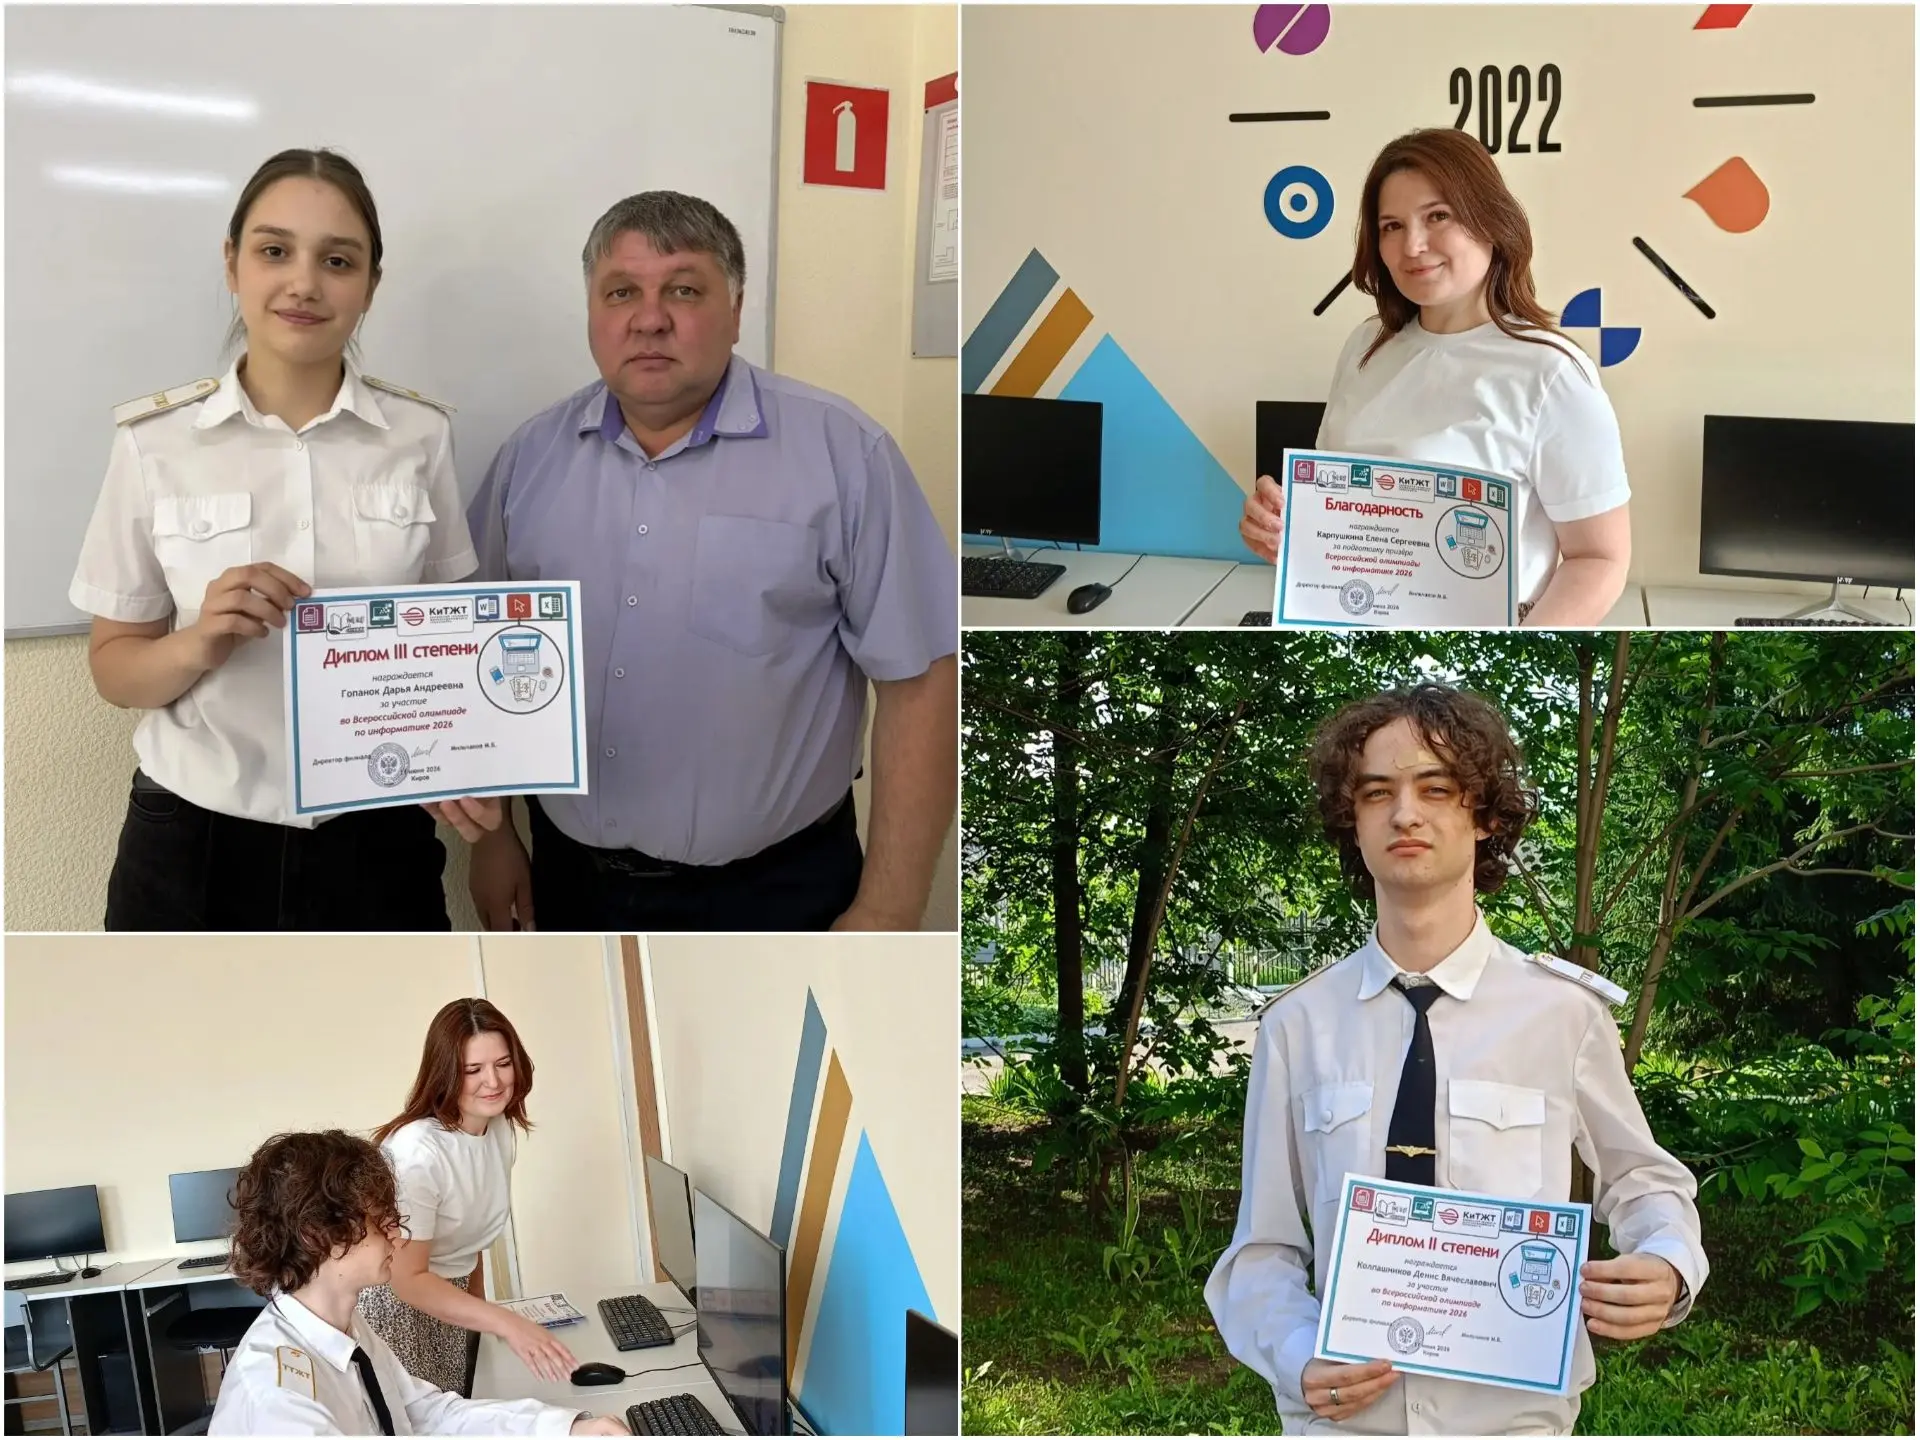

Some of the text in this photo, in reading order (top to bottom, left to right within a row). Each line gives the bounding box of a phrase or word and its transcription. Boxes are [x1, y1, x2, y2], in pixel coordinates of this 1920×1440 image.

[1449, 63, 1561, 155] 2022
[1398, 477, 1430, 488] КиТЖТ
[1325, 497, 1424, 519] Благодарность
[1349, 523, 1400, 533] награждается
[1317, 531, 1430, 548] Карпушкина Елена Сергеевна
[1342, 544, 1384, 554] подготовку
[1325, 552, 1421, 567] Всероссийской олимпиады
[1342, 565, 1394, 575] информатике
[1395, 569, 1413, 577] 2026
[429, 605, 468, 616] КиТЖТ
[479, 603, 487, 611] W
[323, 643, 479, 669] Диплом III степени
[372, 670, 434, 682] награждается
[341, 682, 464, 698] Гопанок Дарья Андреевна
[380, 697, 428, 709] за участие
[340, 706, 467, 725] во Всероссийской олимпиаде
[354, 721, 454, 737] по информатике 2026
[1463, 1211, 1497, 1221] КиТЖТ
[1367, 1228, 1500, 1259] Диплом II степени
[1404, 1258, 1458, 1271] награждается
[1357, 1261, 1497, 1288] Колпашников Денис Вячеславович
[1417, 1282, 1448, 1293] участие
[1382, 1288, 1438, 1303] Всероссийской
[1439, 1298, 1481, 1308] олимпиаде
[1393, 1302, 1447, 1315] информатике
[1449, 1308, 1468, 1318] 2026
